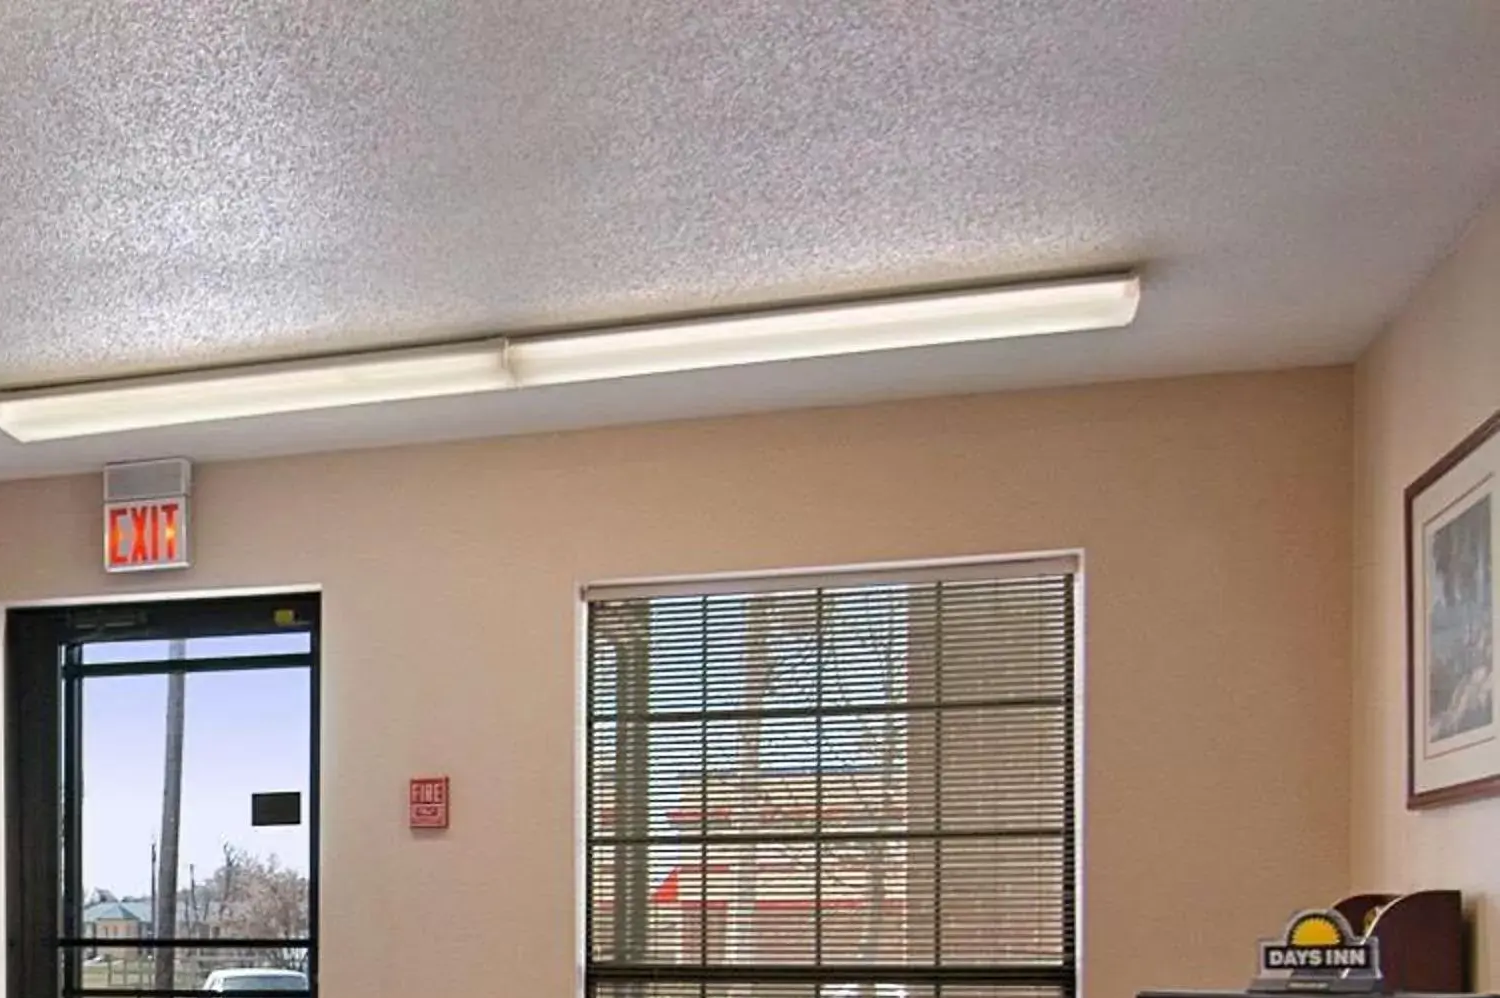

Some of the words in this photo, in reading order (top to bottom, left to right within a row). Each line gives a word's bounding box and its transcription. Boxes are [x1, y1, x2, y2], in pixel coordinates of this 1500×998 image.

[109, 503, 179, 563] EXIT
[1268, 949, 1322, 966] DAYS
[1325, 948, 1366, 966] INN
